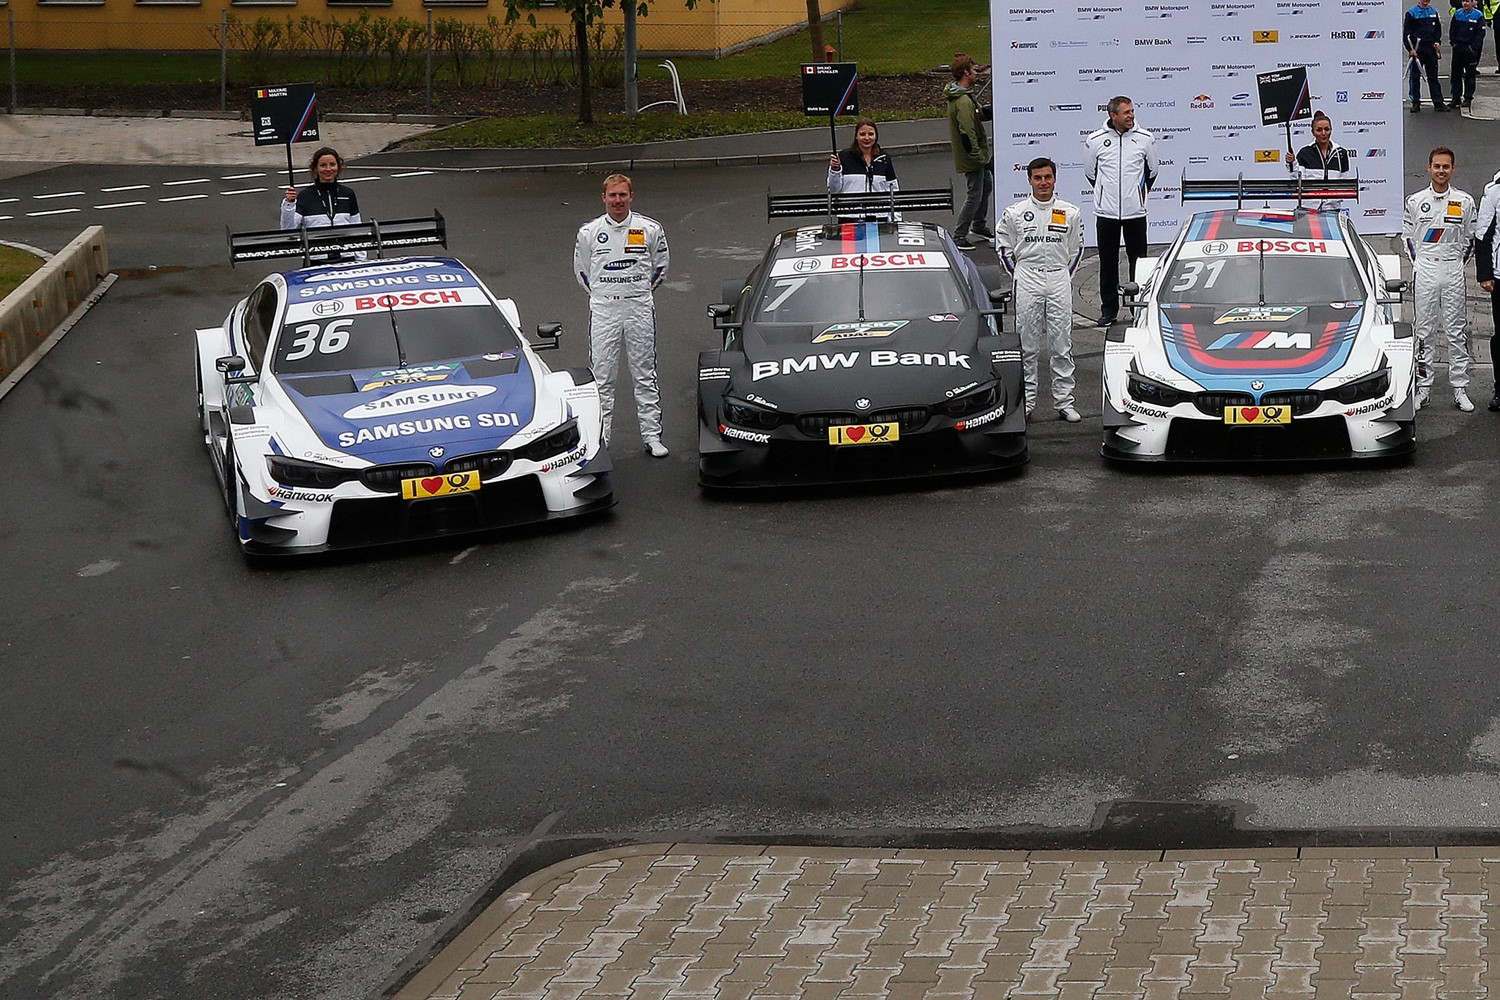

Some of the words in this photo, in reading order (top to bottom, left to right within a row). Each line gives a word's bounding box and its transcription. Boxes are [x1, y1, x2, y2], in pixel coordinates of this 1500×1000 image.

[1147, 100, 1175, 108] randstad
[1149, 219, 1178, 227] randstad
[1237, 242, 1326, 253] BOSCH
[831, 255, 925, 269] BOSCH
[300, 275, 419, 297] SAMSUNG
[425, 273, 465, 284] SDI
[1172, 260, 1227, 292] 31
[355, 290, 463, 311] BOSCH
[764, 278, 808, 312] 7
[285, 319, 355, 361] 36
[752, 351, 859, 382] BMW
[870, 350, 971, 369] Bank
[364, 390, 479, 411] SAMSUNG
[338, 418, 472, 448] SAMSUNG
[476, 412, 520, 428] SDI
